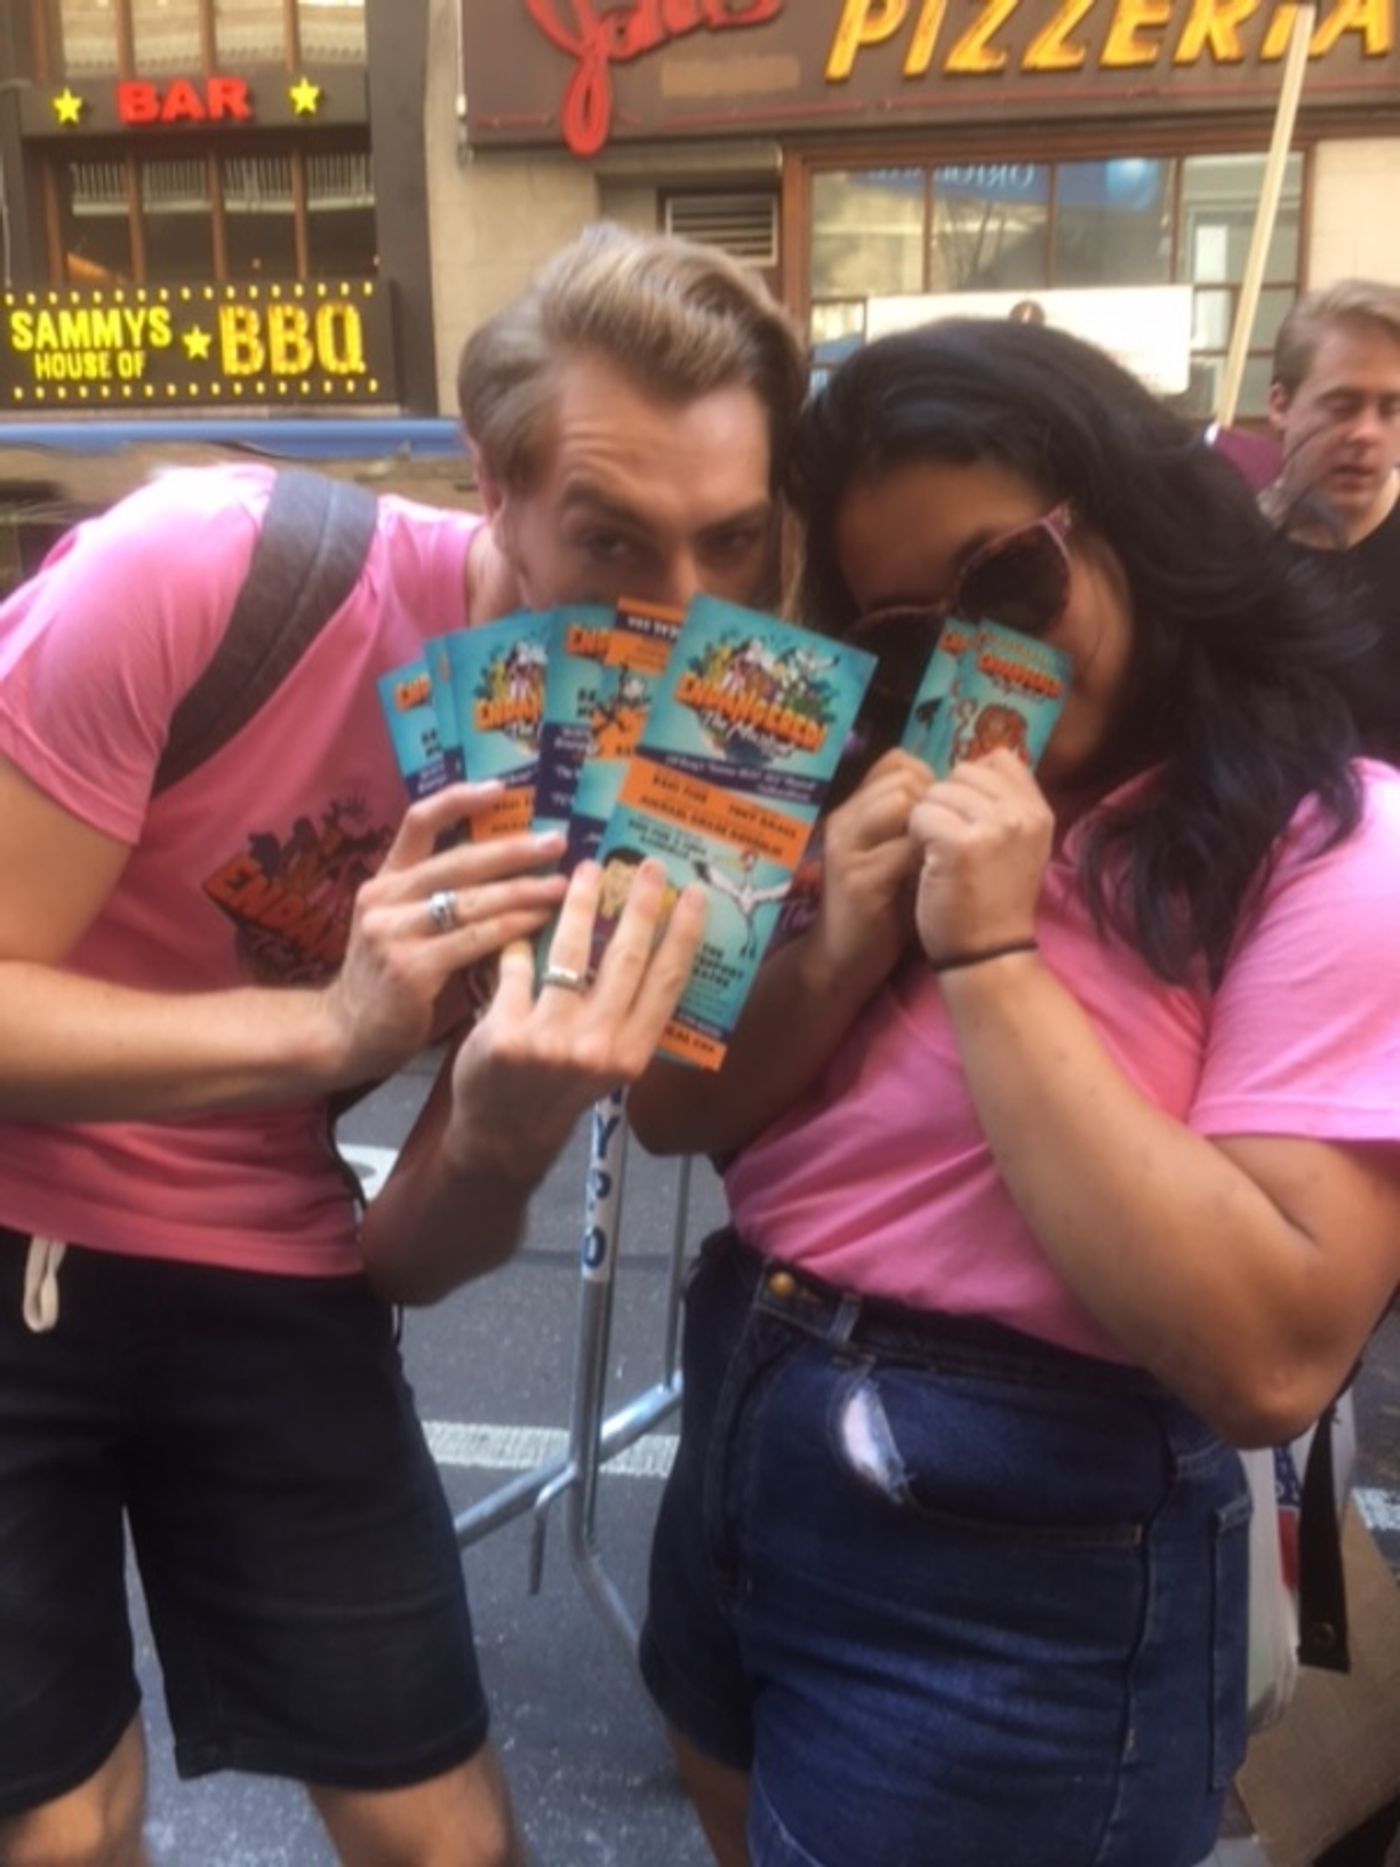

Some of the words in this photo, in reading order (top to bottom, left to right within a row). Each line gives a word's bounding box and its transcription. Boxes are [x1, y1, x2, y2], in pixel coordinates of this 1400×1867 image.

[117, 76, 250, 124] BAR
[10, 305, 172, 351] SAMMYS
[218, 303, 367, 376] BBQ
[35, 350, 111, 380] HOUSE
[118, 350, 145, 378] OF
